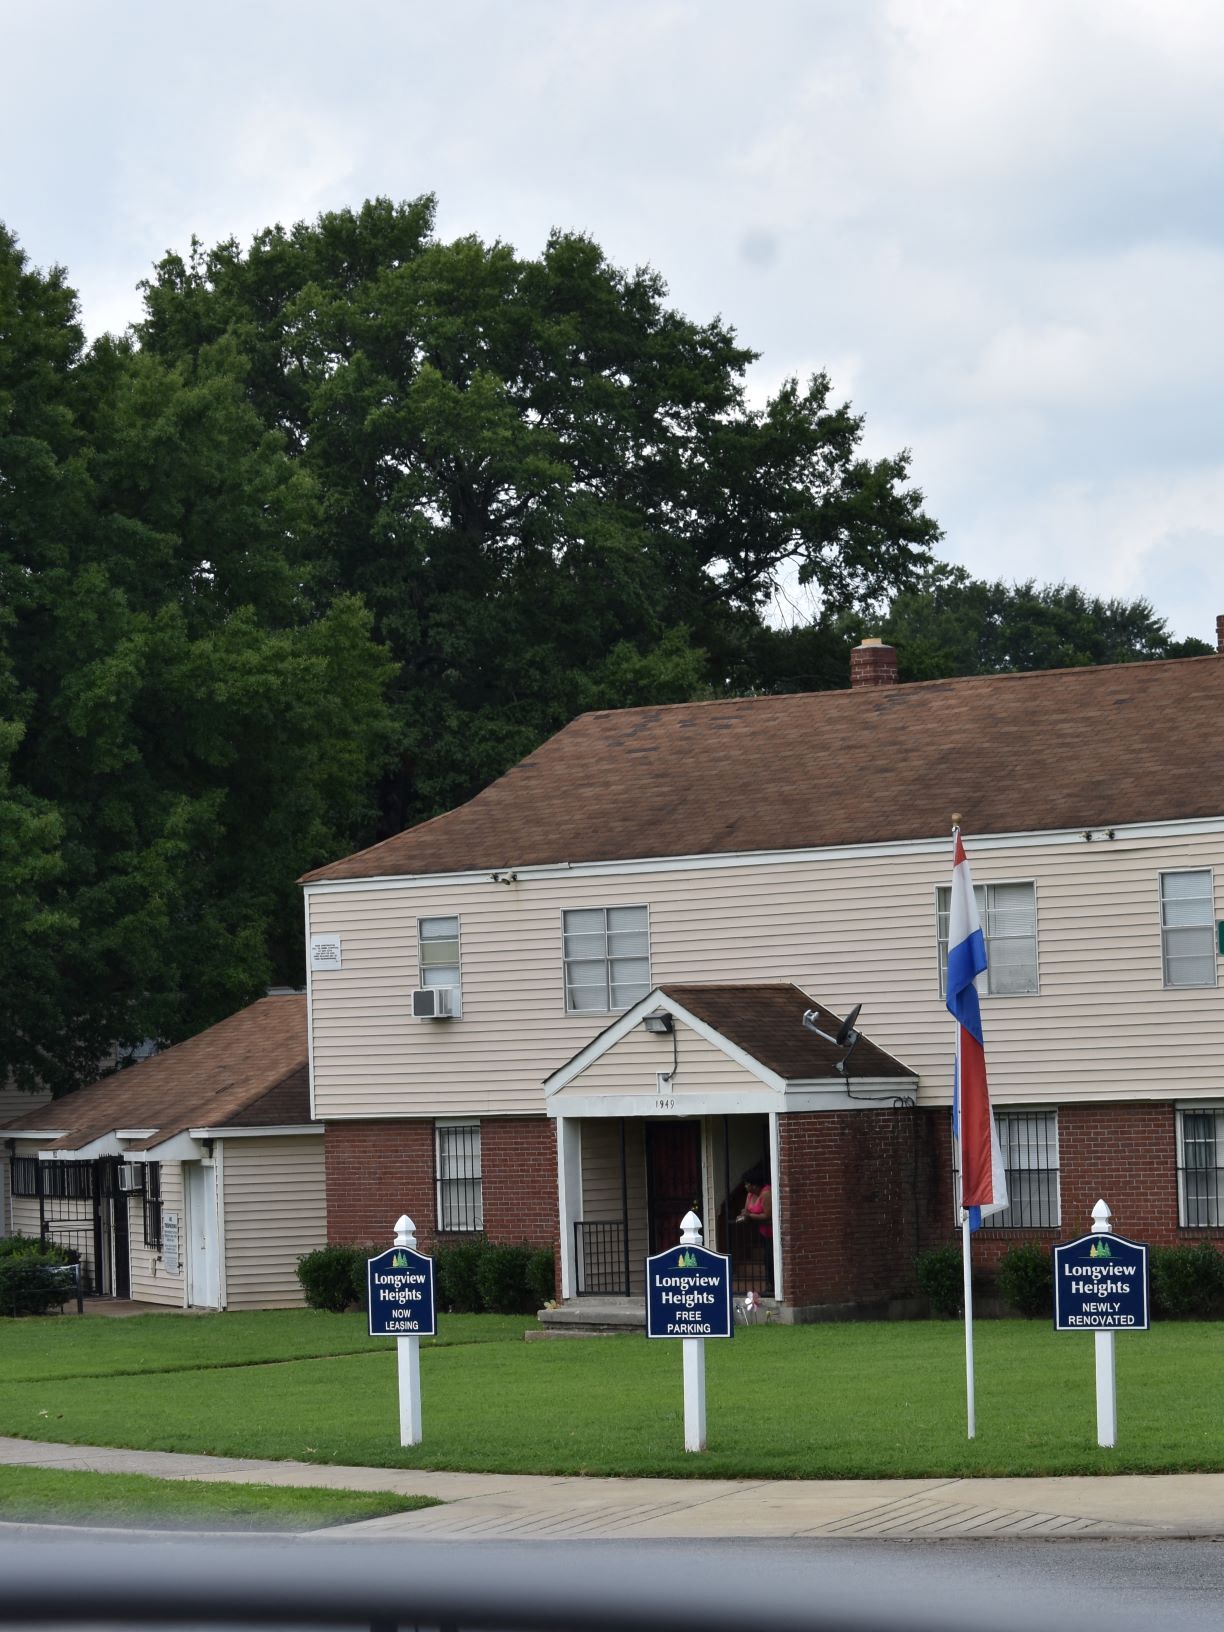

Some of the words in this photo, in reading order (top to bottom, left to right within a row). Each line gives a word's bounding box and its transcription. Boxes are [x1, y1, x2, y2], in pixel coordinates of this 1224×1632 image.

[655, 1099, 675, 1110] 1949
[1064, 1262, 1136, 1280] Longview
[374, 1271, 426, 1288] Longview
[655, 1273, 720, 1291] Longview
[1071, 1279, 1130, 1298] Heights
[379, 1287, 422, 1305] Heights
[661, 1290, 715, 1308] Heights
[1082, 1302, 1120, 1312] NEWLY
[392, 1309, 411, 1319] NOW
[675, 1311, 702, 1321] FREE
[1068, 1315, 1135, 1325] RENOVATED
[385, 1321, 419, 1331] LEASING
[667, 1323, 711, 1334] PARKING
